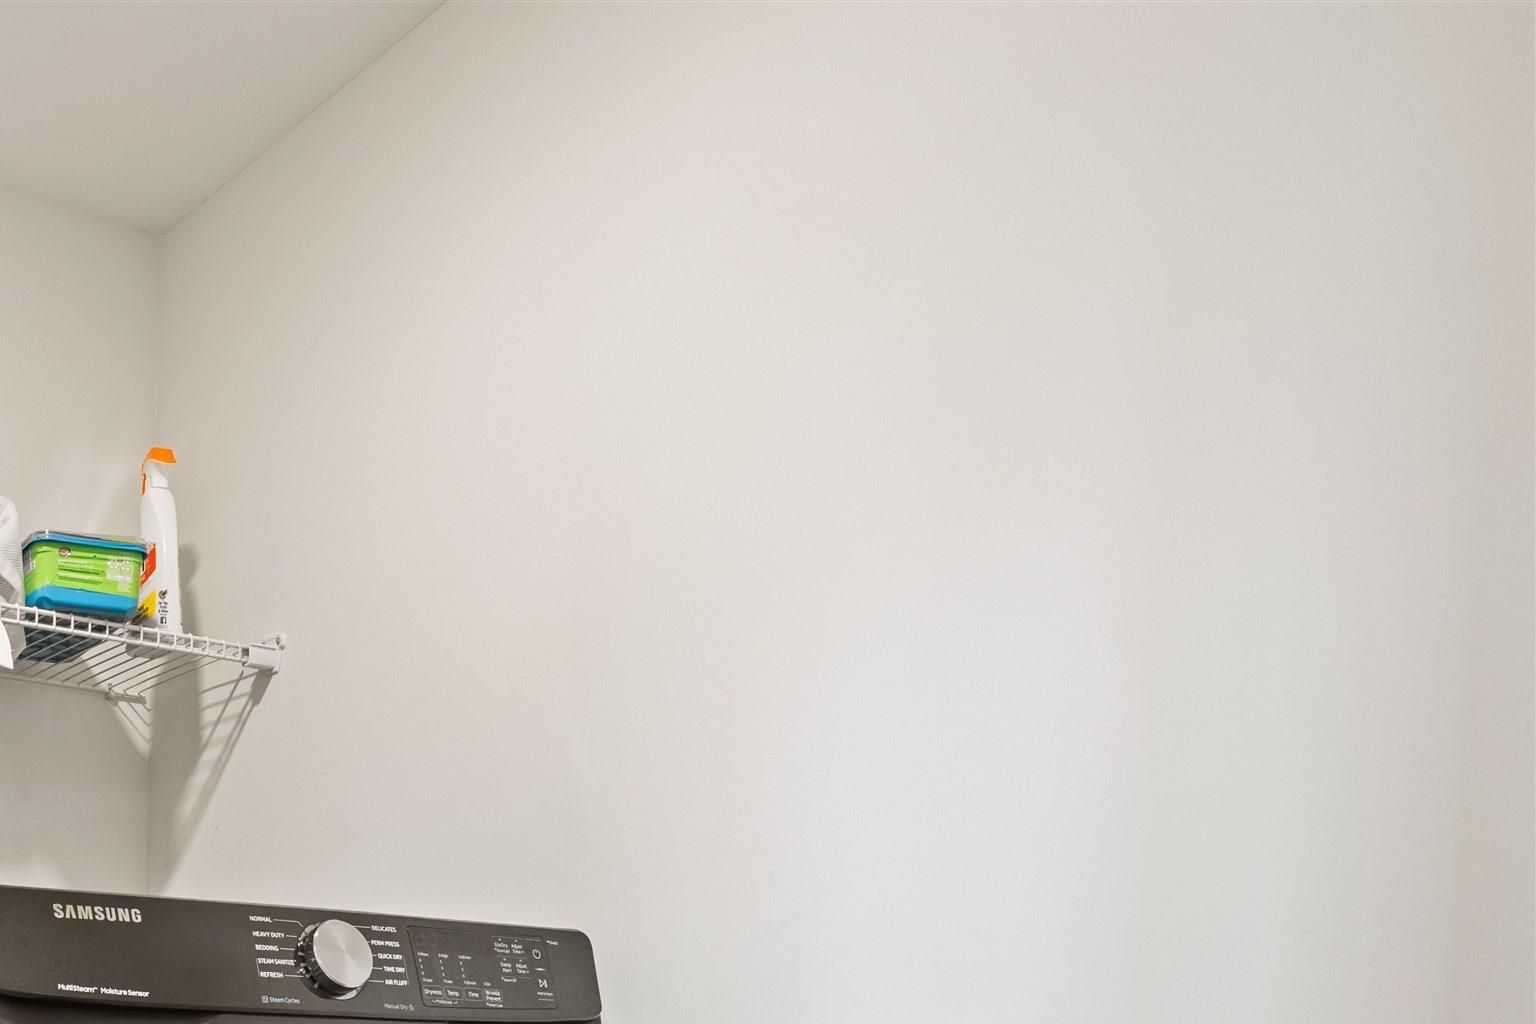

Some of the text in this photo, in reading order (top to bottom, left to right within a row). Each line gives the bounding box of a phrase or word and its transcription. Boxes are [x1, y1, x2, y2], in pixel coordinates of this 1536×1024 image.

[52, 903, 143, 924] SAMSUNG
[249, 915, 273, 923] NORMAL
[252, 930, 270, 938] HEAVY
[100, 987, 150, 997] Moisture Sensor
